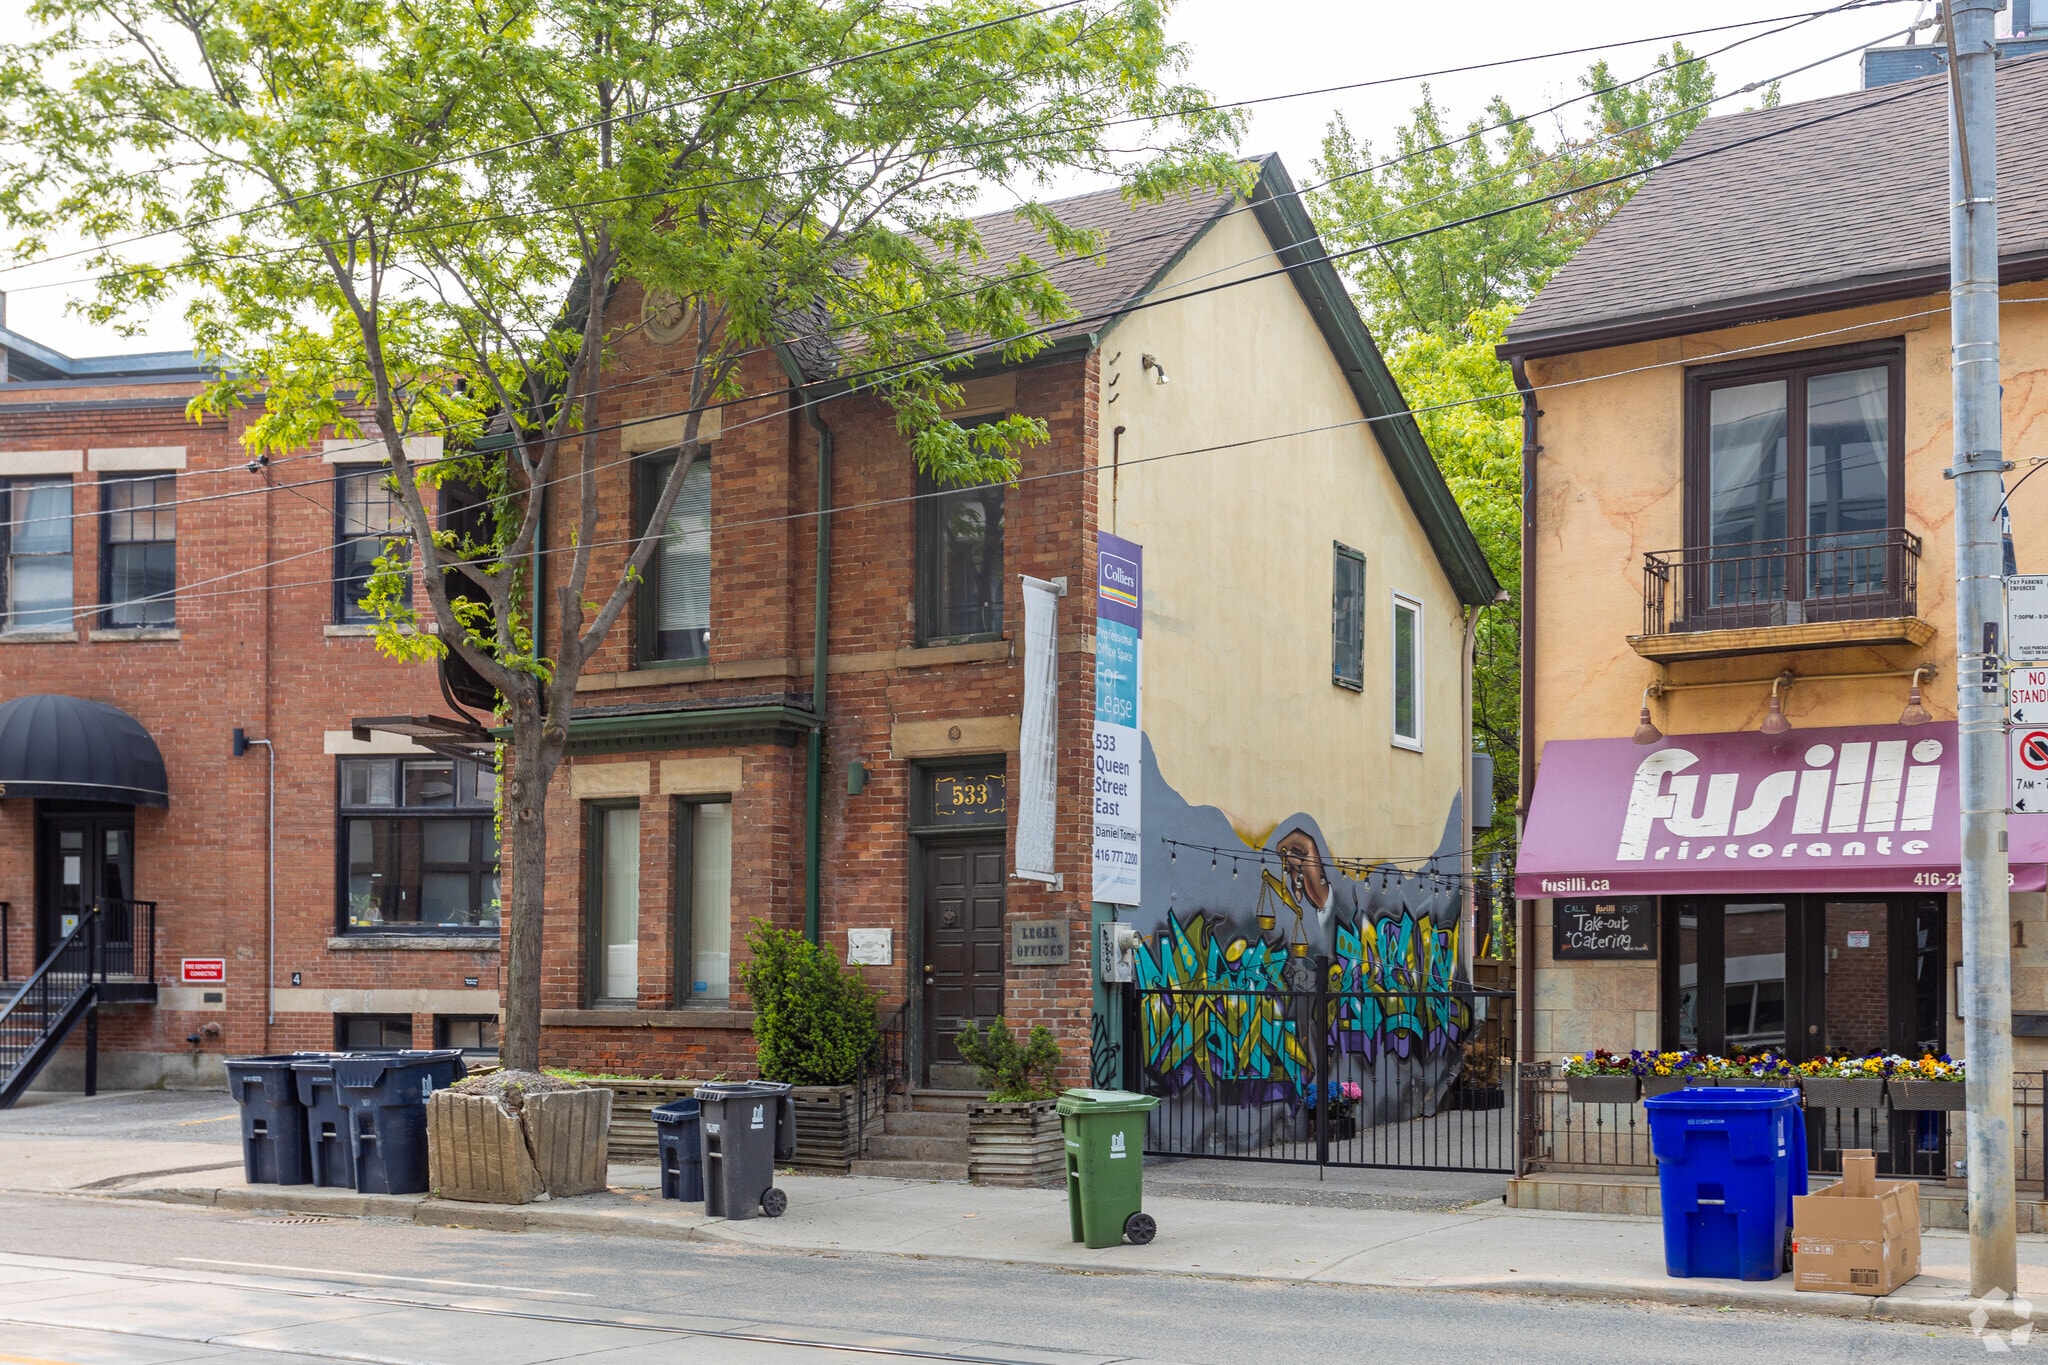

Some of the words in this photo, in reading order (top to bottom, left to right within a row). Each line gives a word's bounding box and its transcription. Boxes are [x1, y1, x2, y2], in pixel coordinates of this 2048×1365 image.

[1104, 563, 1135, 588] Colliers
[1096, 626, 1132, 646] Professional
[1096, 642, 1116, 658] Office
[1117, 648, 1133, 662] Space
[1095, 661, 1118, 688] For
[2029, 672, 2046, 686] NO
[1095, 688, 1132, 718] Lease
[1096, 733, 1116, 752] 533
[1096, 755, 1130, 776] Queen
[1096, 776, 1128, 797] Street
[2016, 778, 2034, 790] 7AM
[952, 784, 988, 806] 533
[1616, 738, 1943, 861] fusilli
[1096, 797, 1120, 816] East
[1096, 826, 1120, 840] Daniel
[1095, 848, 1110, 862] 416
[1111, 850, 1123, 862] 777
[1124, 852, 1138, 866] 2200
[1655, 836, 1929, 860] ristorante
[1541, 878, 1610, 892] fusilli.ca
[1564, 904, 1588, 913] CALL
[1622, 904, 1638, 914] FOR
[1573, 914, 1630, 932] Take-out
[1022, 926, 1058, 940] LEGAL
[1016, 944, 1064, 957] OFFICES
[293, 974, 300, 985] 4
